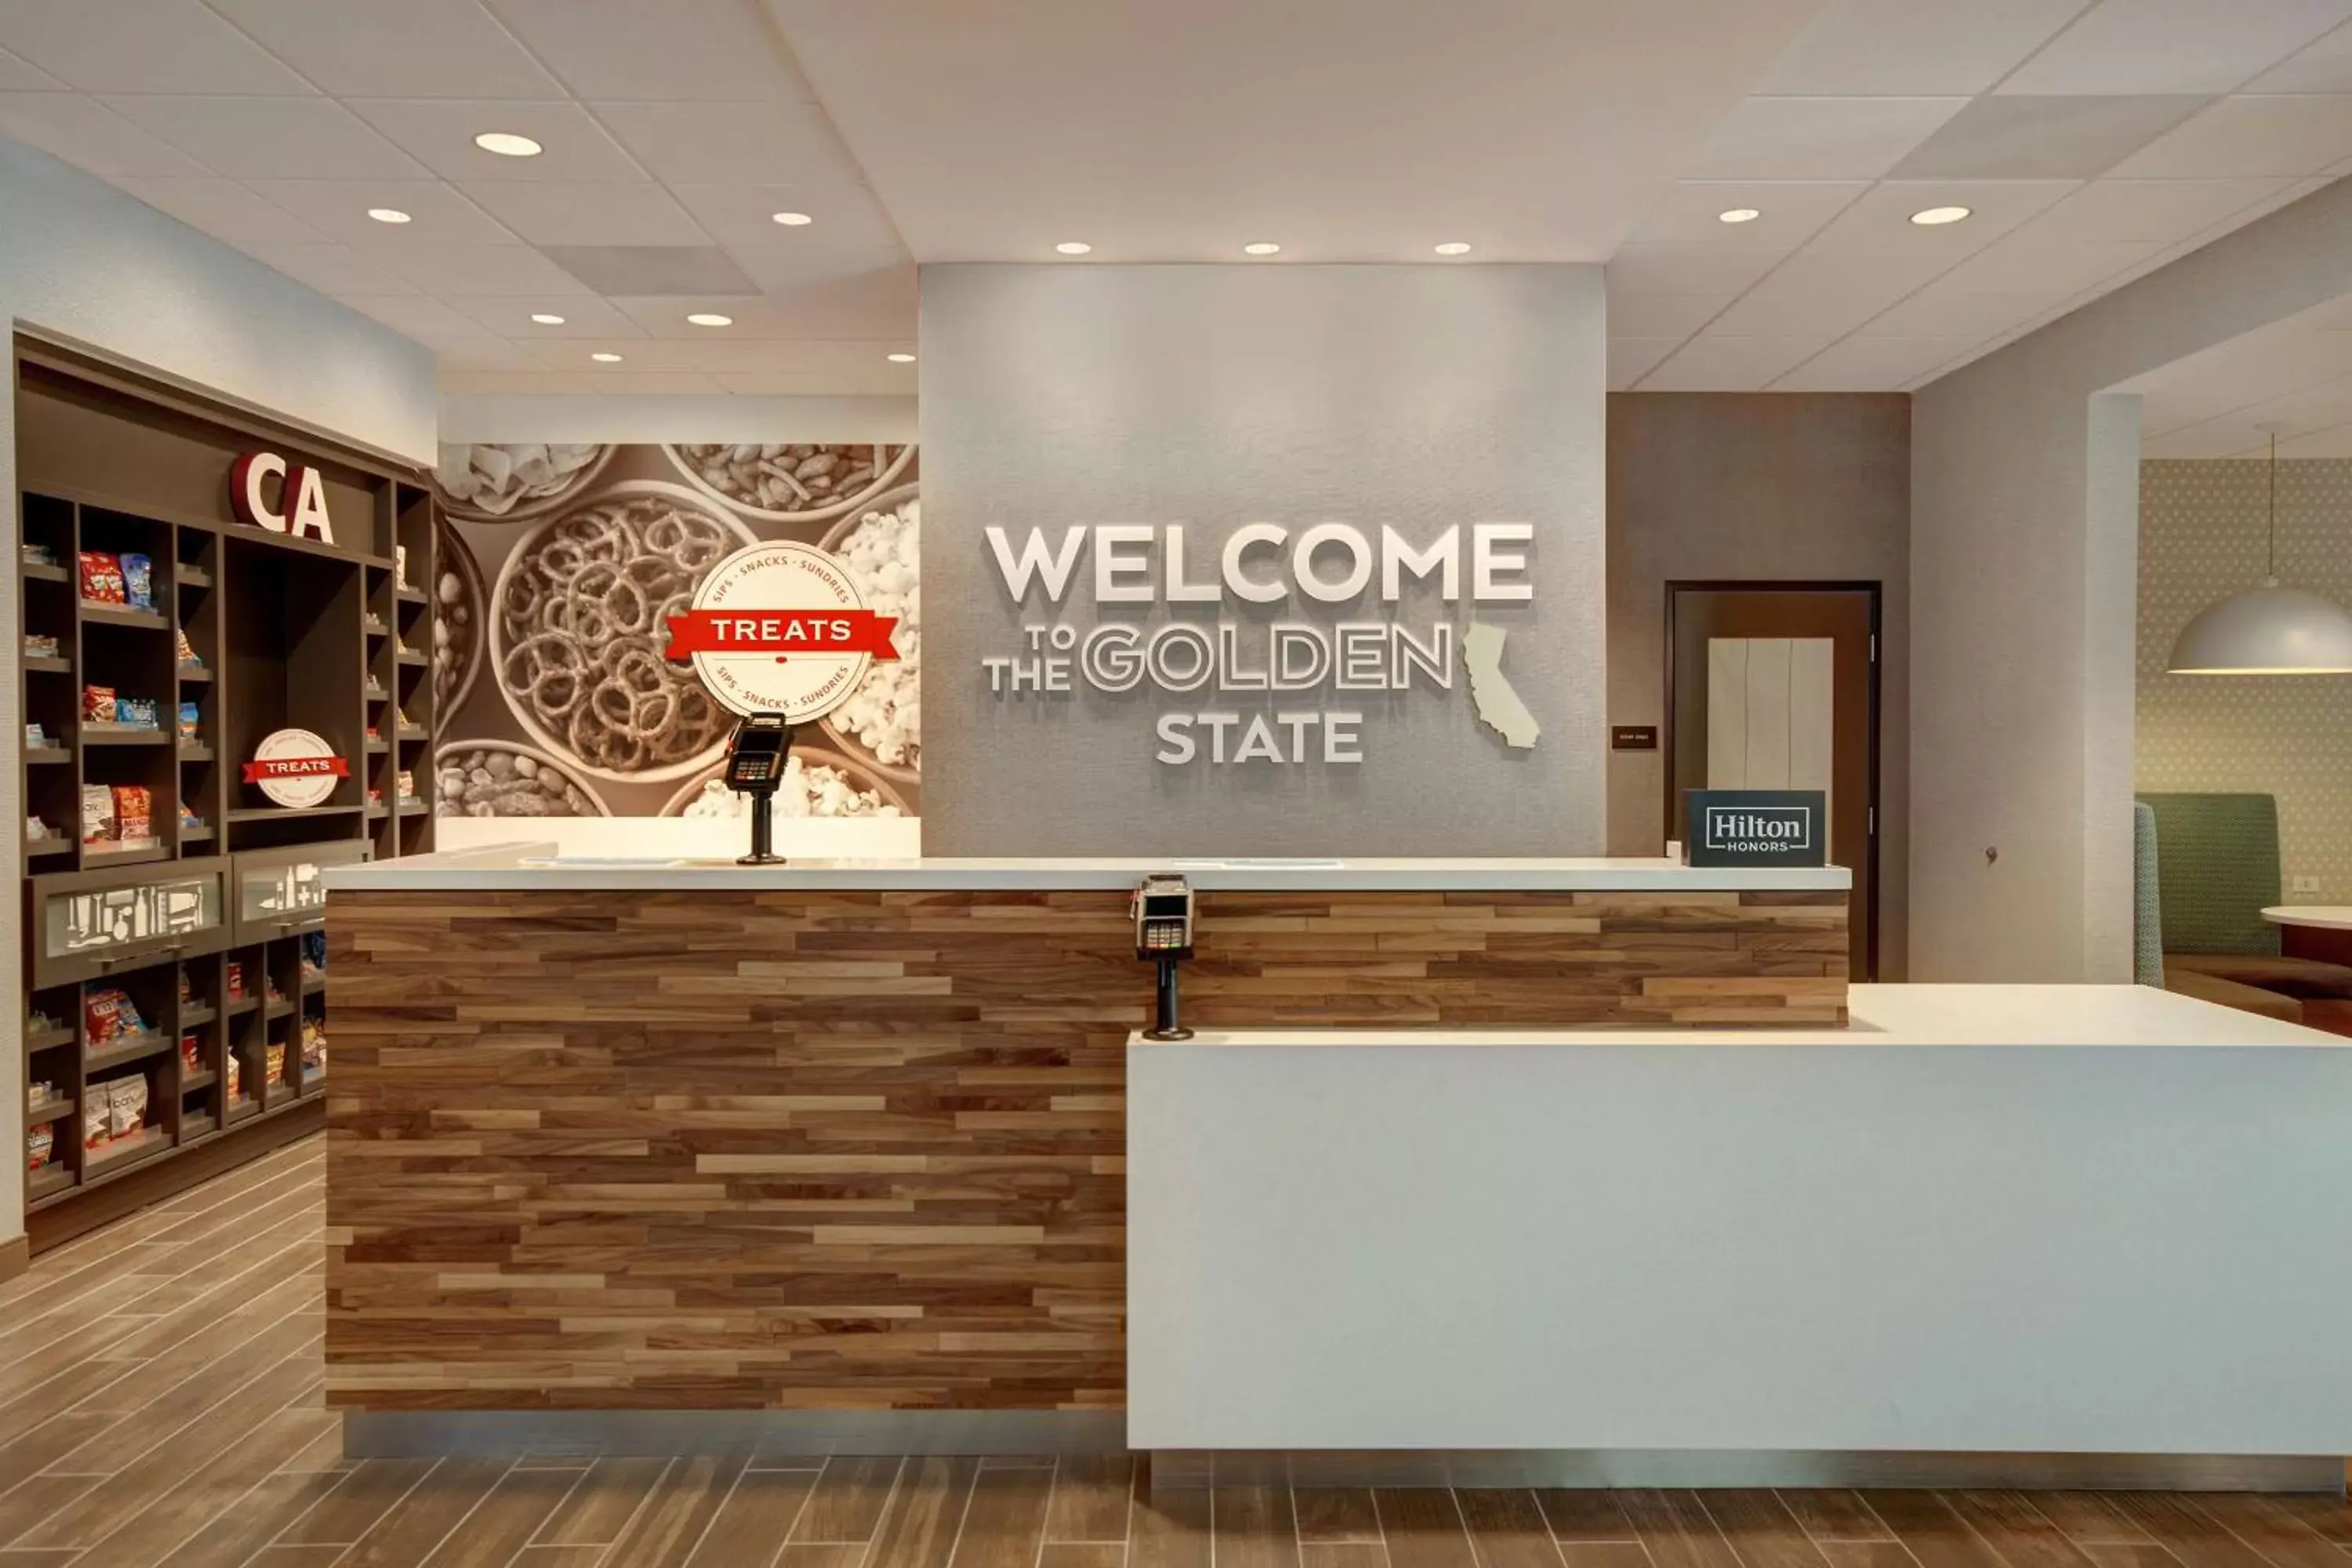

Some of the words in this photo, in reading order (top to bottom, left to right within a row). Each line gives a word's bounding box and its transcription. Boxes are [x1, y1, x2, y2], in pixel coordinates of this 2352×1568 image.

[238, 452, 334, 544] CA
[713, 580, 733, 602] SIPS
[739, 556, 788, 576] SNACKS
[800, 560, 849, 603] SUNDRIES
[983, 522, 1534, 604] WELCOME
[710, 619, 851, 641] TREATS
[1025, 625, 1076, 651] TO
[982, 657, 1072, 691] THE
[1081, 623, 1453, 692] GOLDEN
[717, 666, 737, 688] SIPS
[743, 691, 789, 709] SNACKS
[800, 666, 848, 706] SUNDRIES
[1155, 712, 1364, 765] STATE
[265, 760, 331, 774] TREATS
[1714, 814, 1801, 839] Hilton
[1726, 840, 1788, 852] HONORS
